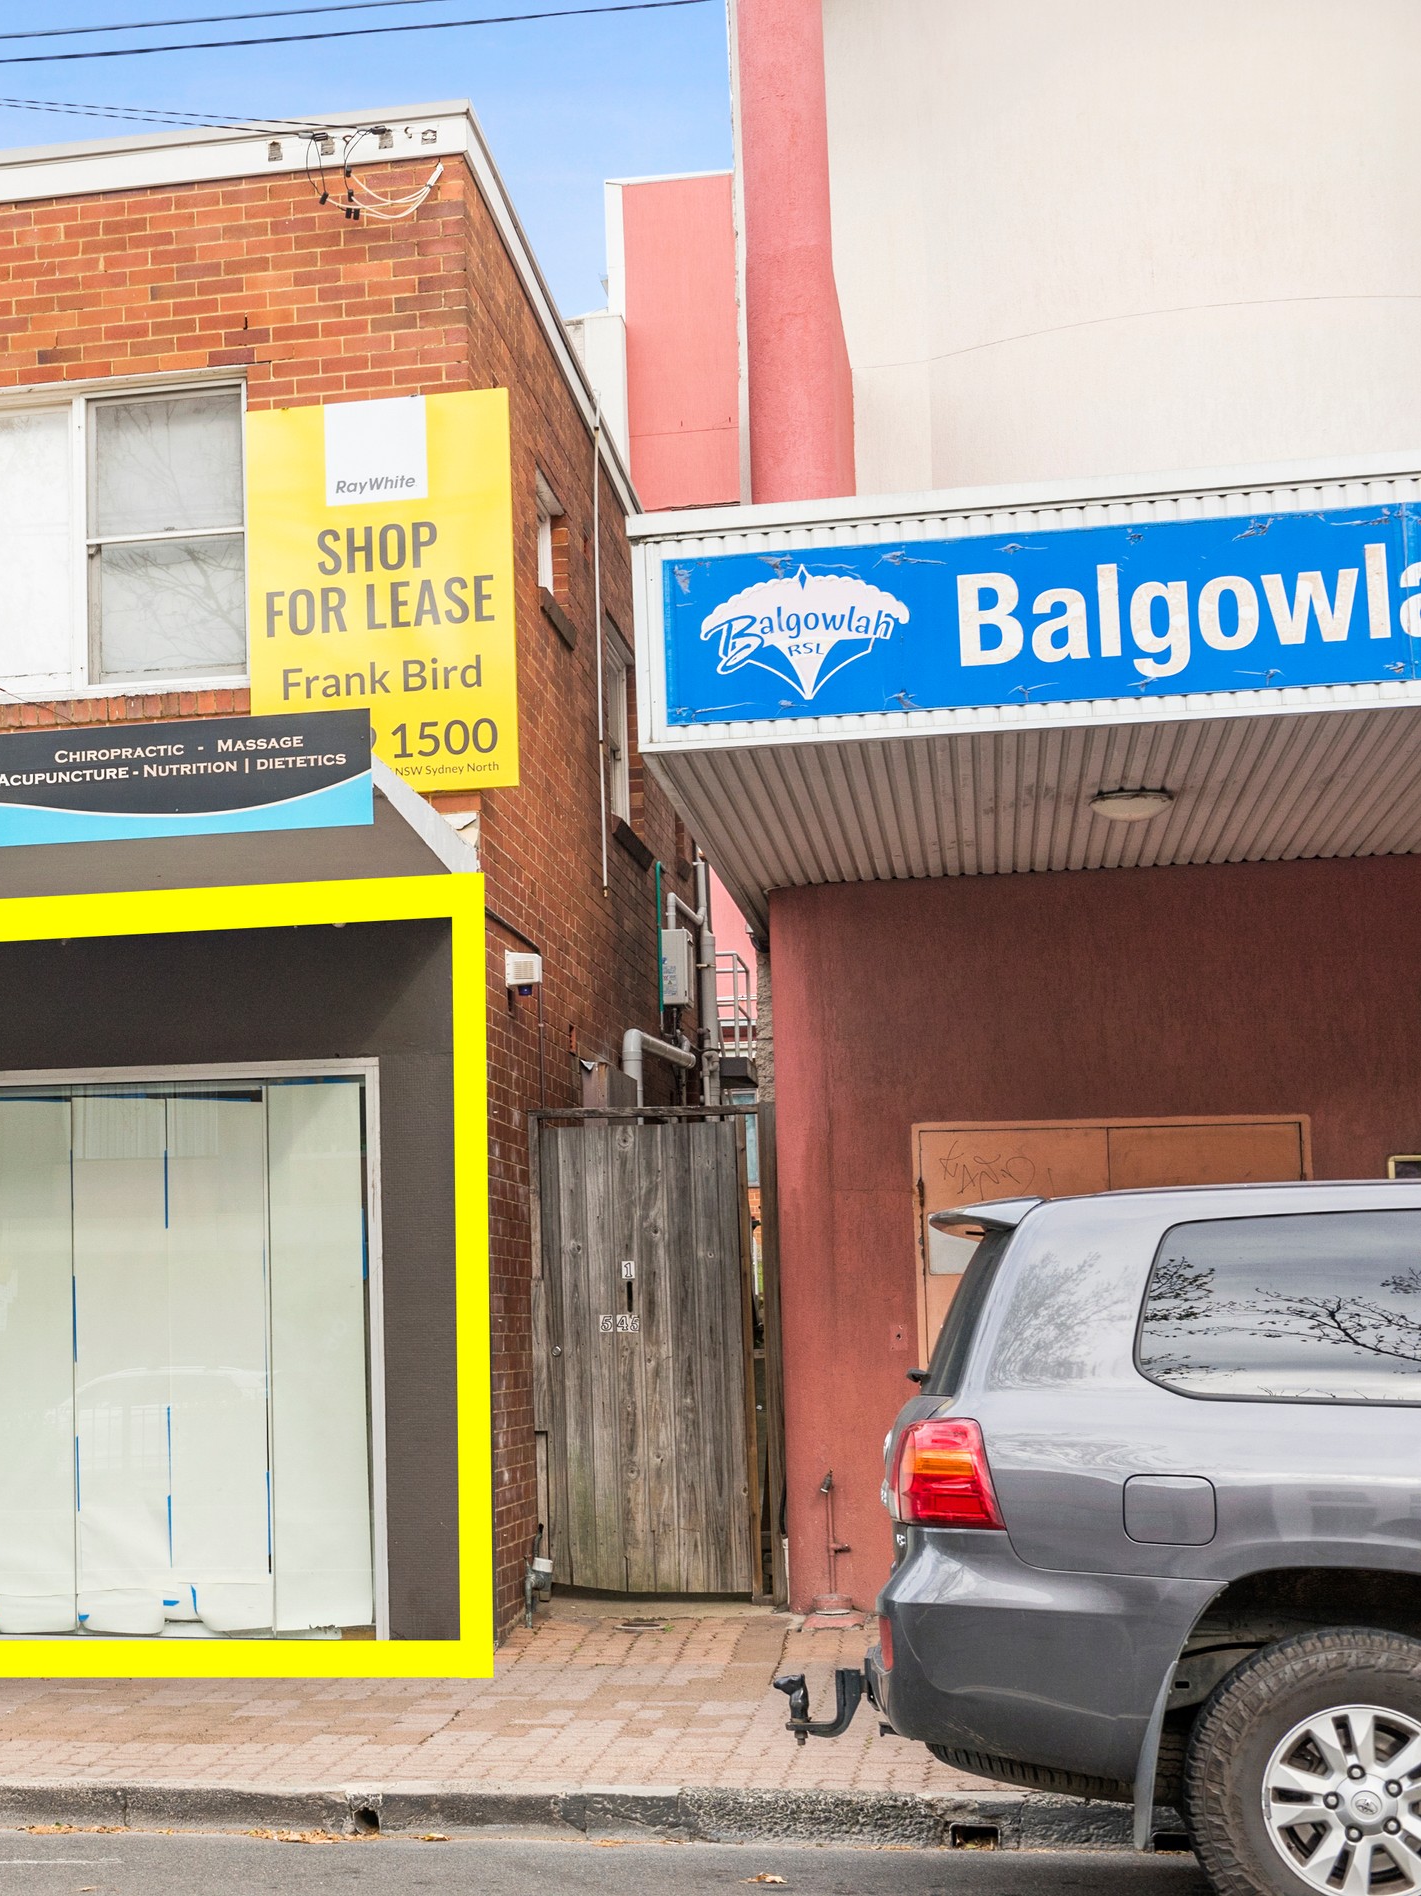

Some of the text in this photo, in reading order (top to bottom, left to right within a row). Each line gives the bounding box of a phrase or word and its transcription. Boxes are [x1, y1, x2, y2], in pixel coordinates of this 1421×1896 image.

[316, 520, 438, 577] SHOP
[265, 574, 496, 638] FOR LEASE
[703, 606, 894, 673] Balgowlah
[787, 642, 825, 657] RSL
[282, 653, 483, 701] Frank Bird
[391, 717, 499, 759] 1500
[256, 752, 347, 771] DIETETICS
[395, 761, 500, 777] NSW Sydney North
[623, 1262, 633, 1278] 1
[600, 1315, 640, 1332] 545
